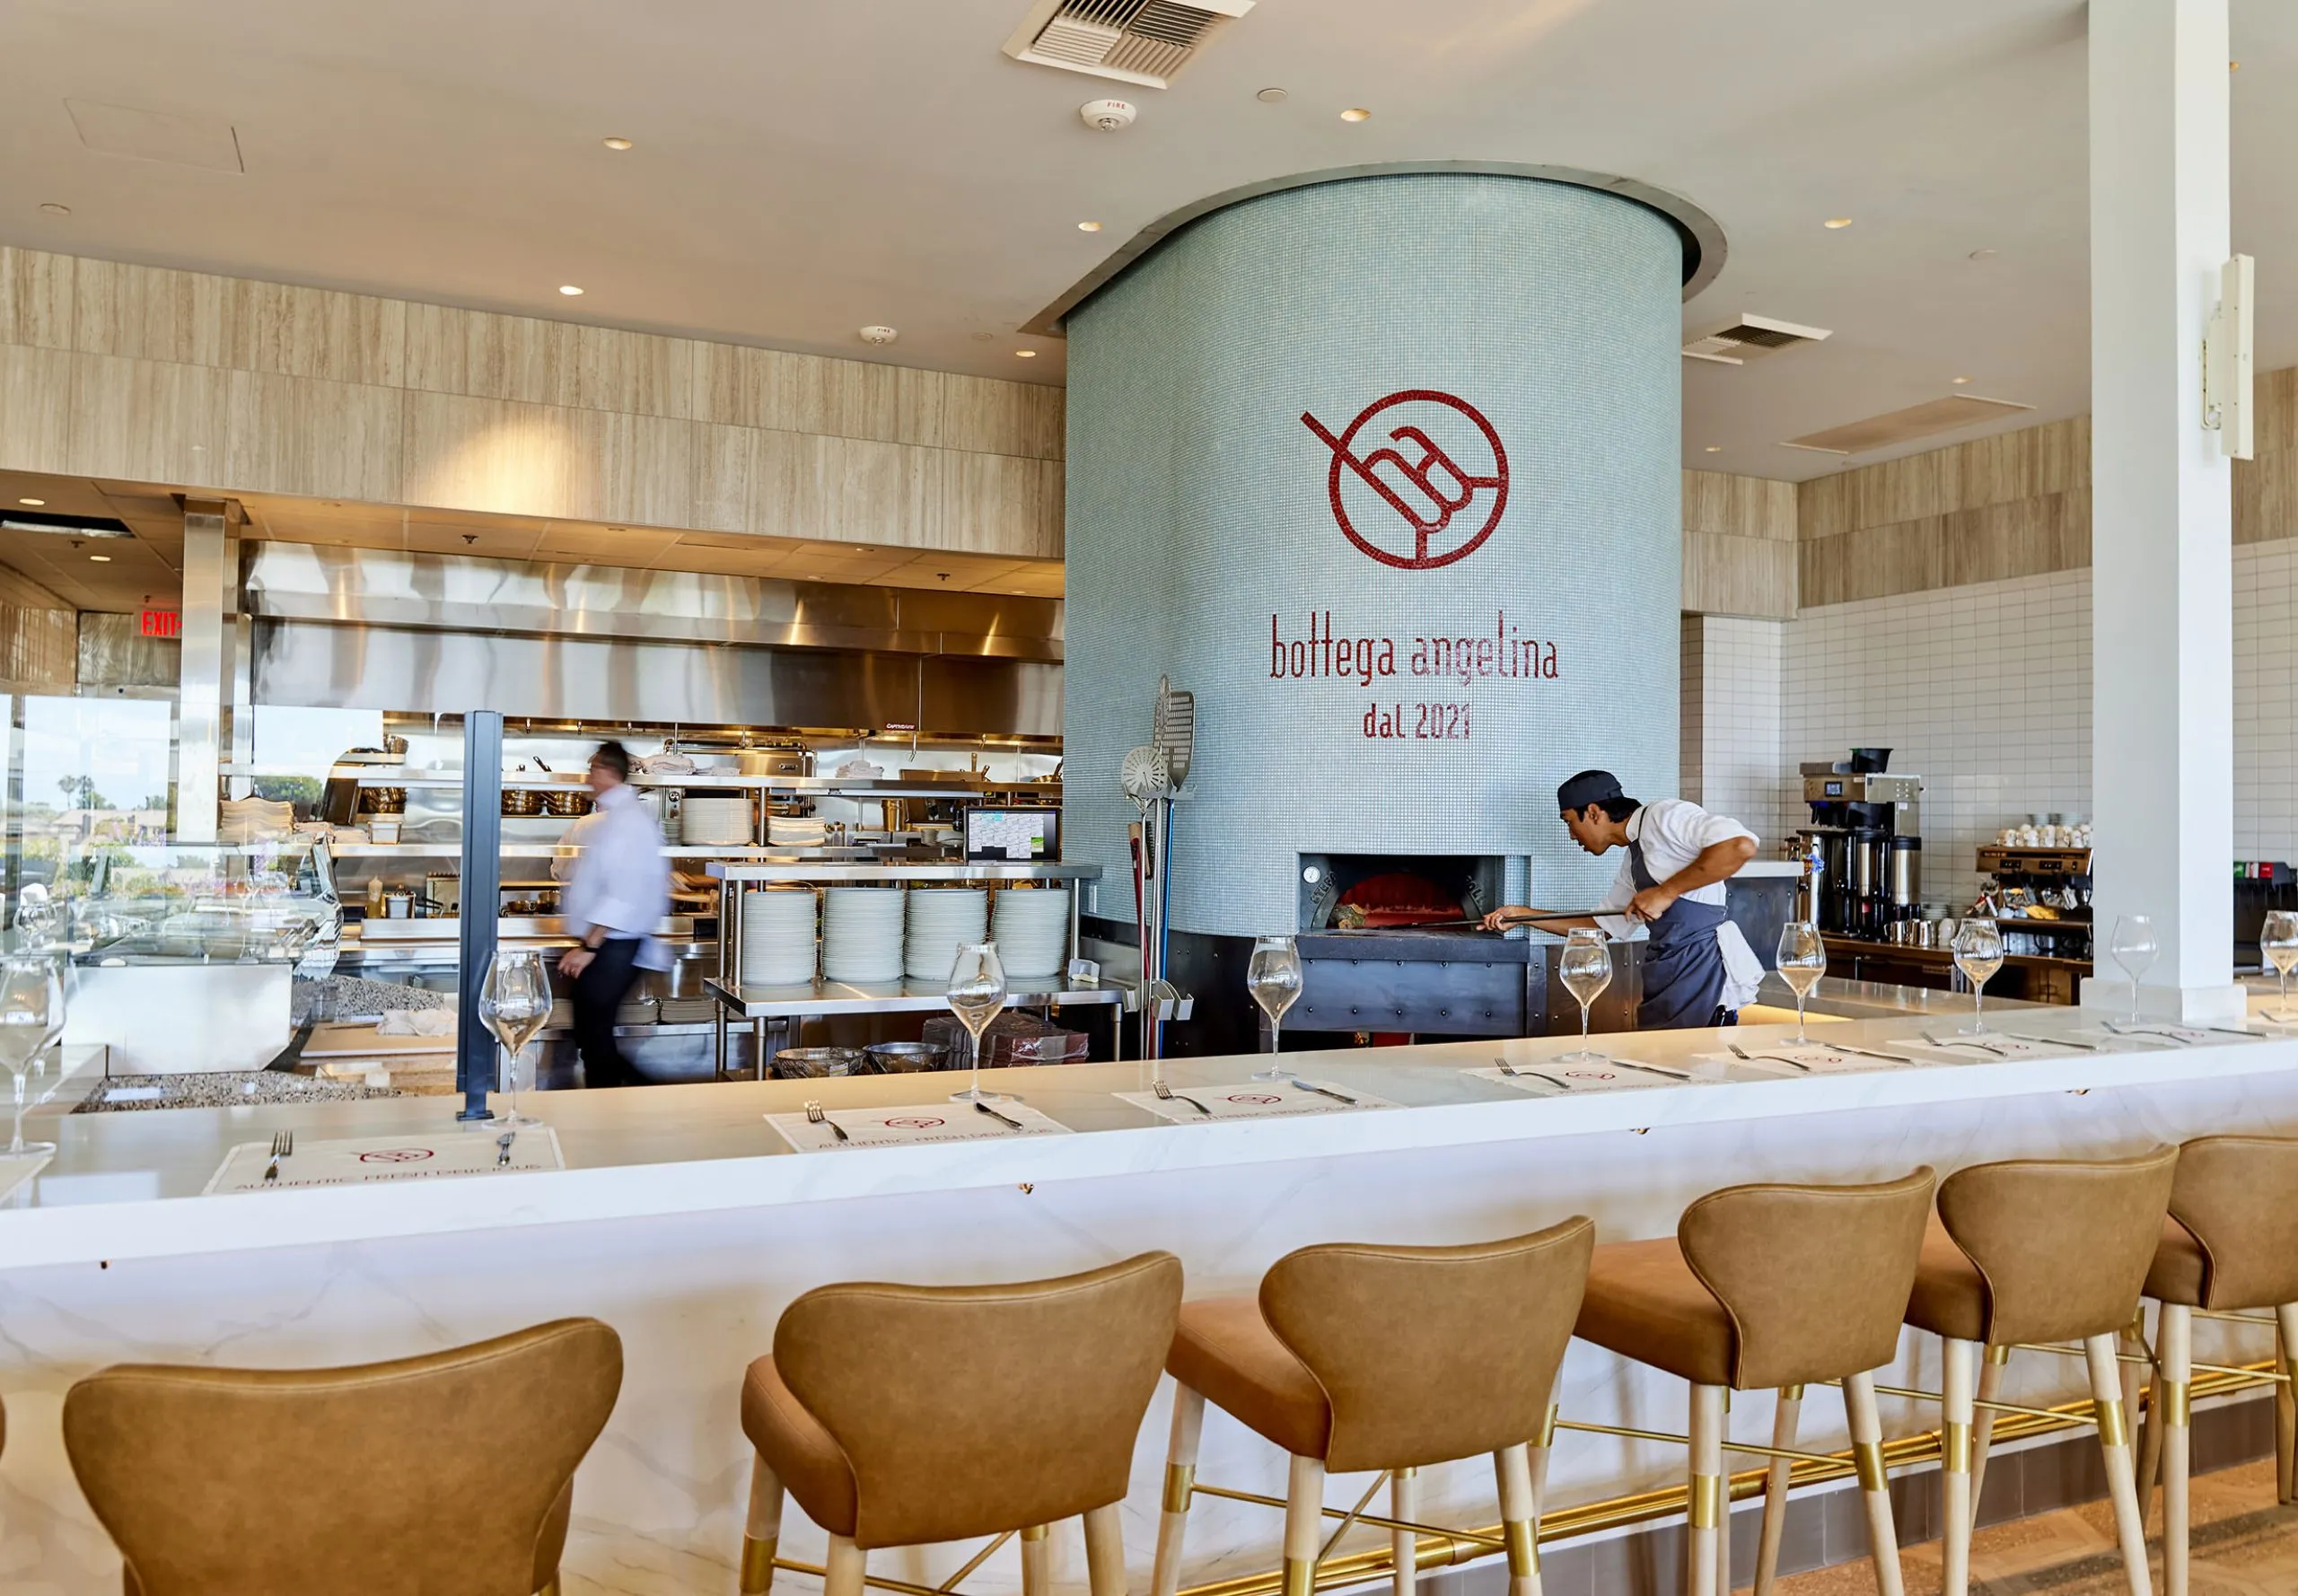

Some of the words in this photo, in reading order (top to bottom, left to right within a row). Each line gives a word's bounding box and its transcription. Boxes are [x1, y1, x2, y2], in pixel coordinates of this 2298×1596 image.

[1106, 101, 1127, 110] FIRE
[142, 610, 178, 636] EXIT
[1270, 610, 1397, 687] bottega
[1411, 609, 1559, 686] angelina
[1364, 703, 1406, 739] dal
[1415, 703, 1470, 739] 2021
